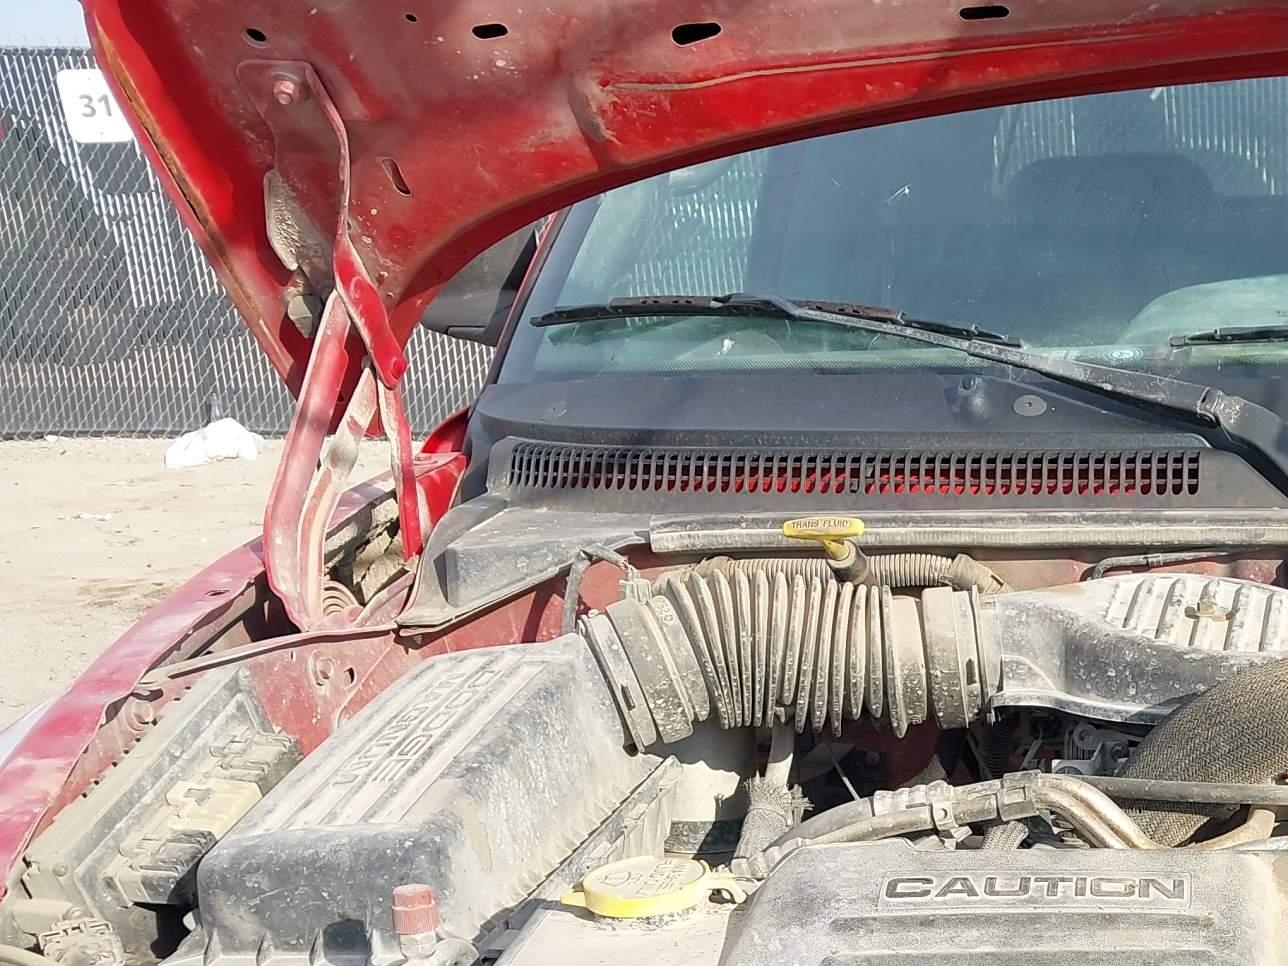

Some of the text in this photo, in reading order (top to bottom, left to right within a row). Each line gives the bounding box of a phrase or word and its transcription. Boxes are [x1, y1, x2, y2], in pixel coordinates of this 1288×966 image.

[79, 94, 112, 117] 31
[822, 519, 849, 528] FLUID
[368, 668, 505, 785] DODGE
[885, 876, 1185, 900] CAUTION
